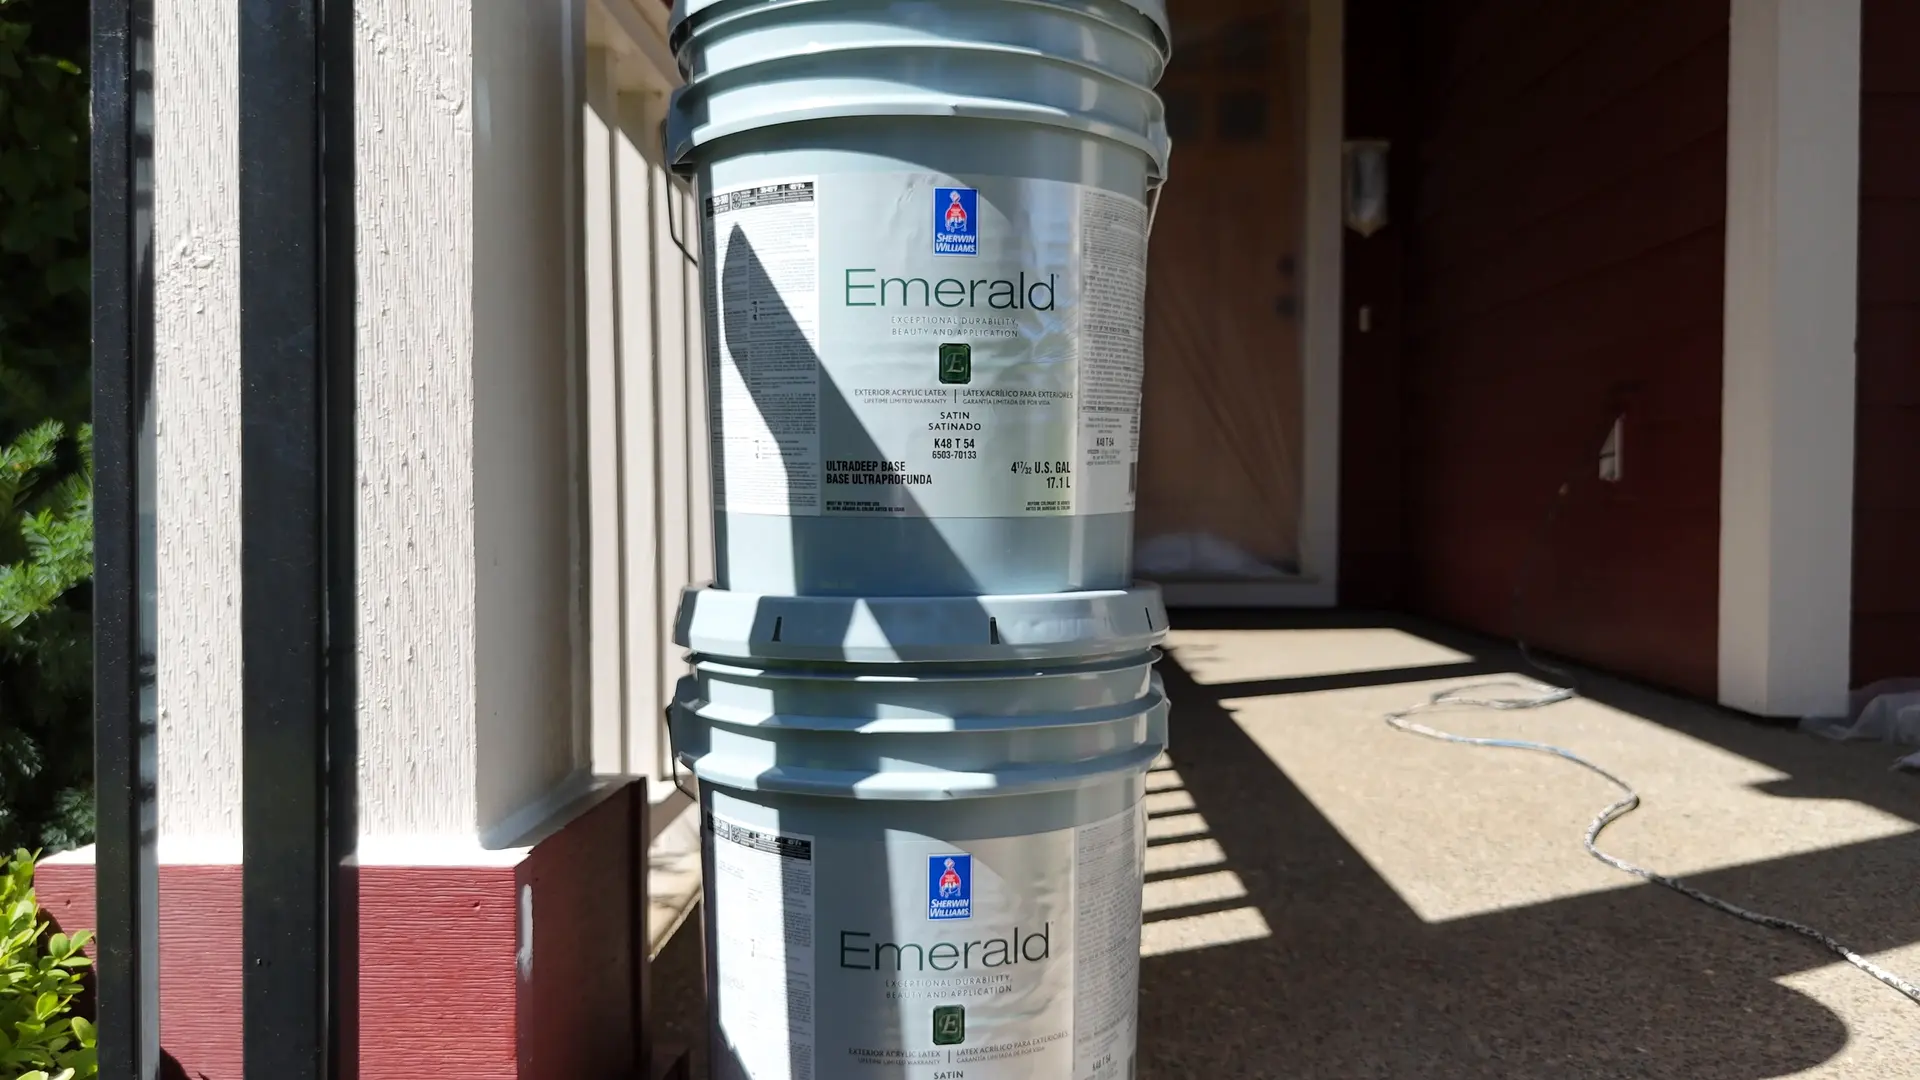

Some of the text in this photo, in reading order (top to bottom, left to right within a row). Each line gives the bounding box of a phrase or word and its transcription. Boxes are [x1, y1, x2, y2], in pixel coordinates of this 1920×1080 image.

[936, 232, 976, 244] SHERWIN
[845, 268, 1055, 311] Emerald
[891, 316, 958, 325] EXCEPTIONAL
[892, 328, 929, 336] BEAUTY
[957, 329, 1018, 338] APPLICATION
[854, 388, 947, 397] EXTERIOR ACRYLIC LATEX
[1020, 389, 1037, 398] PARA
[940, 411, 970, 420] SATIN
[928, 422, 981, 431] SATINADO
[934, 438, 975, 449] K48 T 54
[932, 450, 977, 460] 6503-70133
[826, 461, 906, 472] ULTRADEEP BASE
[1034, 461, 1053, 474] U.S.
[1055, 461, 1071, 474] GAL
[826, 473, 933, 485] BASE ULTRAPROFUNDA
[1046, 476, 1071, 489] 17.1 L
[930, 898, 970, 909] SHERWIN
[840, 922, 1050, 971] Emerald
[885, 979, 952, 988] EXCEPTIONAL
[886, 984, 1013, 999] BEAUTY AND APPLICATION
[933, 1070, 964, 1080] SATIN
